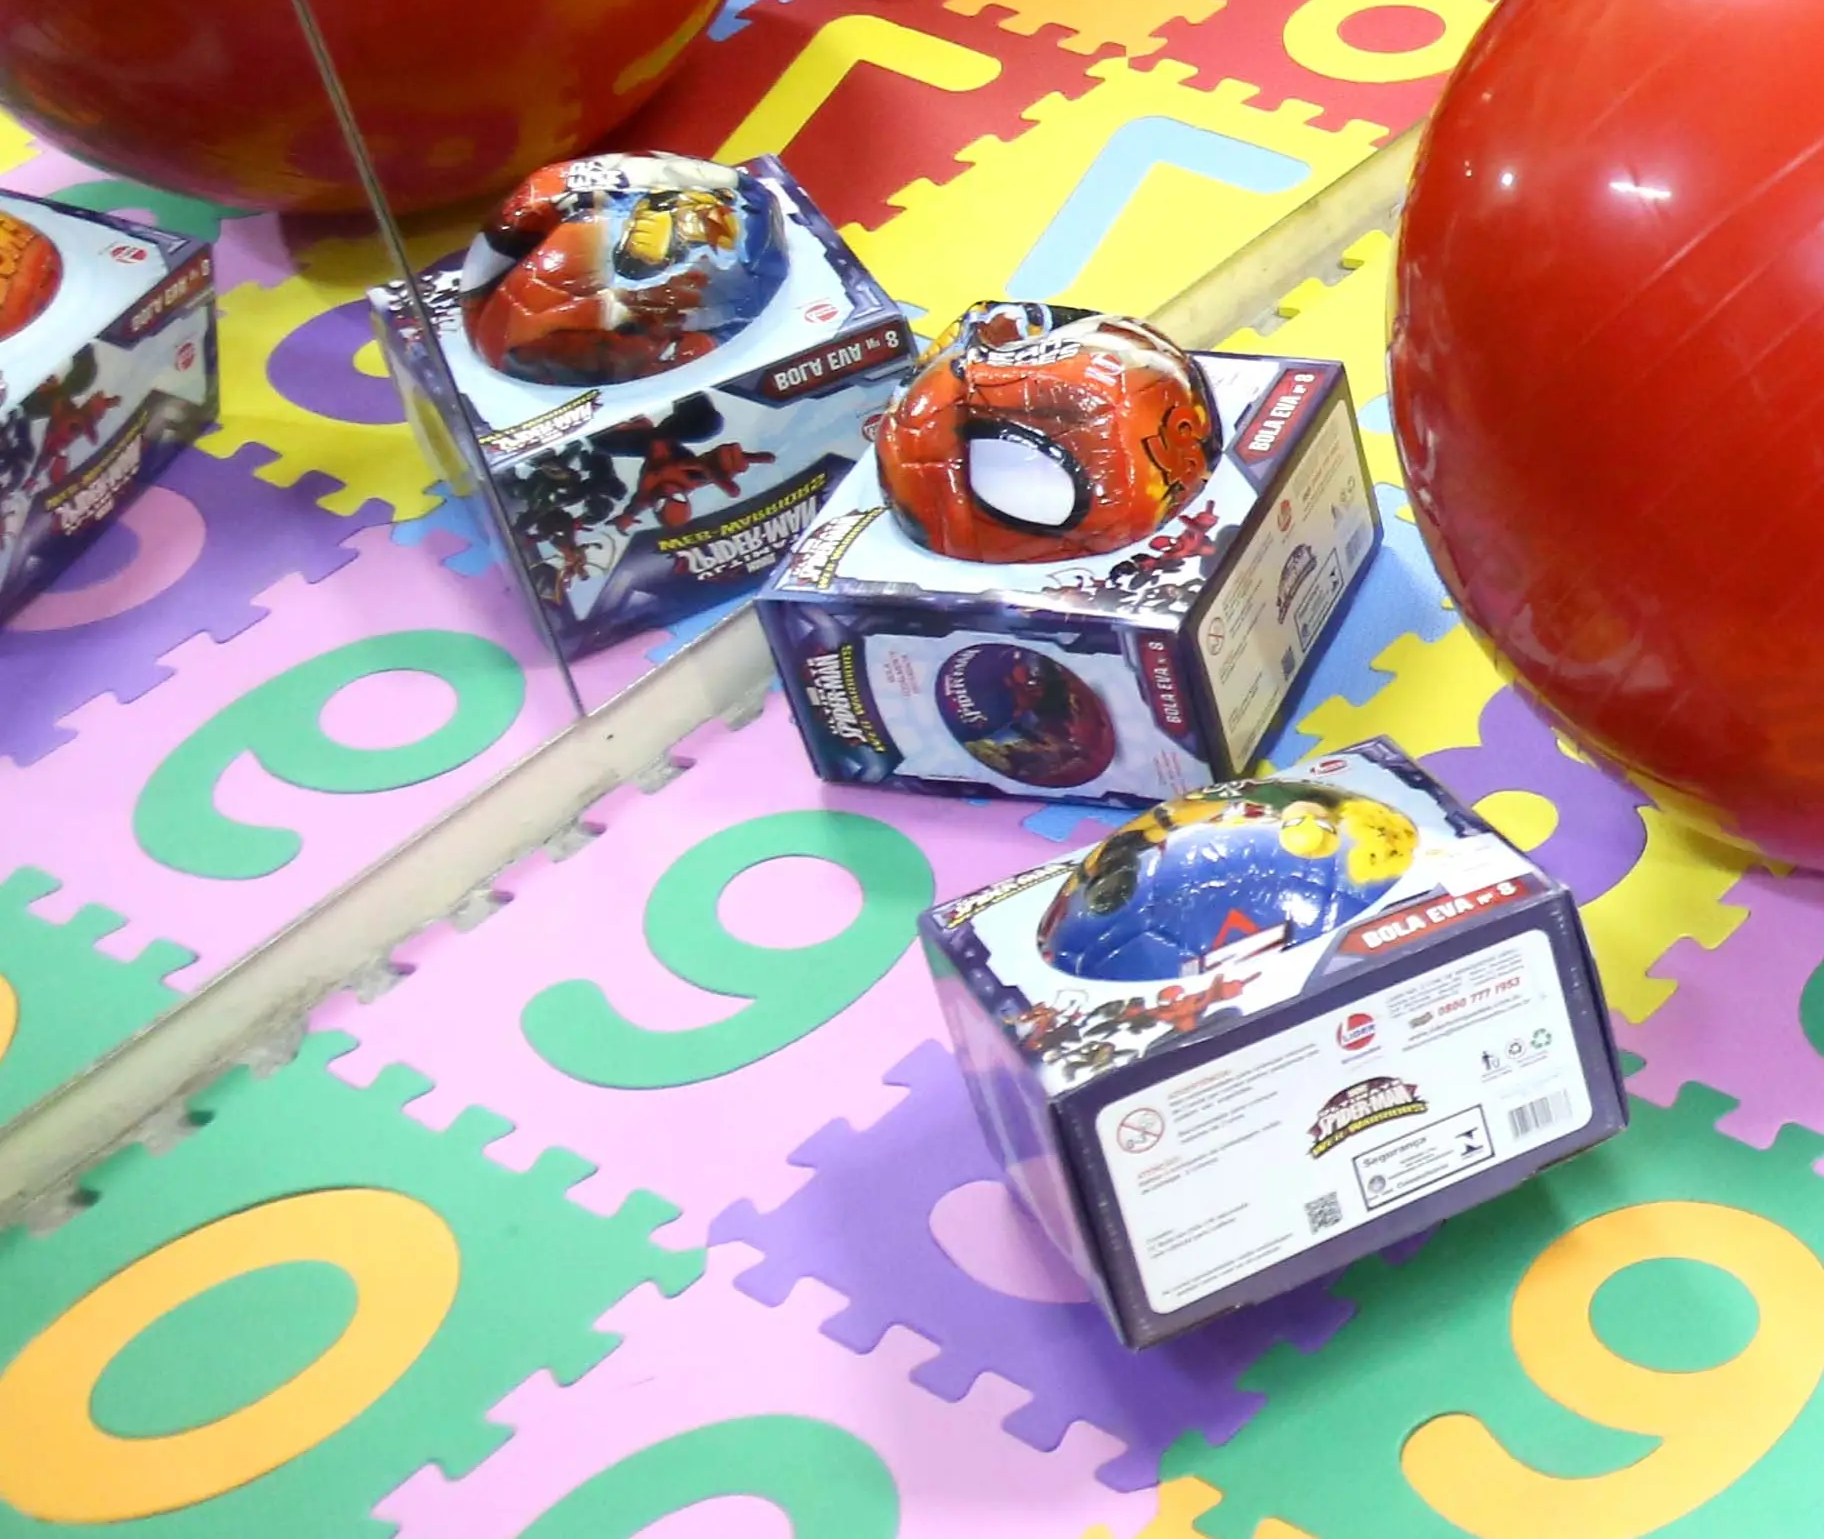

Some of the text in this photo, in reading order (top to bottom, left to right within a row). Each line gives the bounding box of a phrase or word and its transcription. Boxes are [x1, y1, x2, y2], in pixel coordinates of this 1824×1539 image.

[1247, 409, 1283, 453] BOLA
[1274, 389, 1300, 428] EVA
[1299, 372, 1316, 385] 8
[1157, 665, 1174, 692] EVA
[1164, 692, 1182, 725] BOLA
[1360, 911, 1425, 950] BOLA
[1425, 897, 1475, 924] EVA
[1497, 877, 1518, 897] 8
[519, 809, 936, 1089] 9
[1437, 997, 1467, 1017] 0800
[1470, 987, 1492, 1004] 777
[1319, 1083, 1413, 1138] SPIDER-MAN
[1362, 1136, 1428, 1168] Segurança
[0, 1186, 460, 1524] 0
